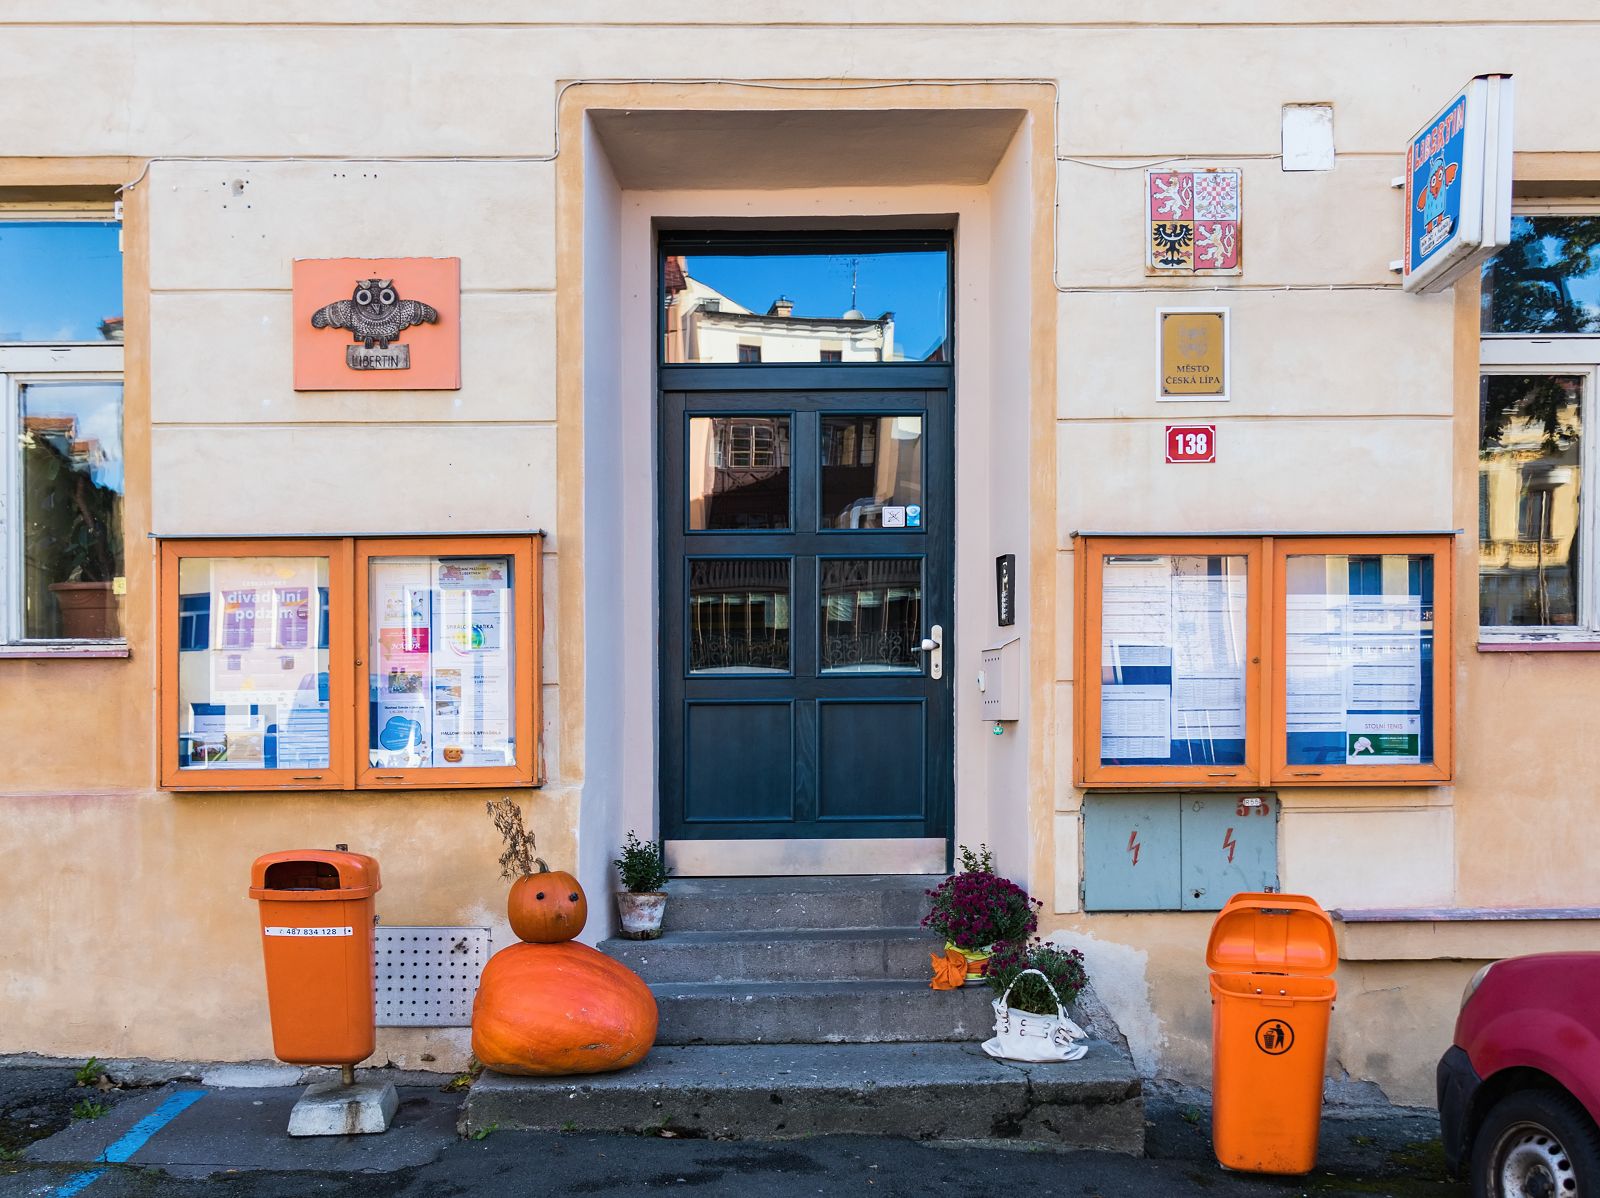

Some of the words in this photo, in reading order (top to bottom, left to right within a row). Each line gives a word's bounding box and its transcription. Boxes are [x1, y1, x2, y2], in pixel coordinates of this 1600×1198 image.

[1414, 100, 1465, 171] LIBERTIN
[352, 355, 399, 368] LIBERTIN
[1176, 364, 1210, 373] MĚSTO
[1165, 376, 1197, 384] ČESKÁ
[1199, 375, 1220, 384] LÍPA
[1175, 433, 1208, 455] 138
[227, 590, 302, 603] divadelní
[235, 607, 294, 622] podzm
